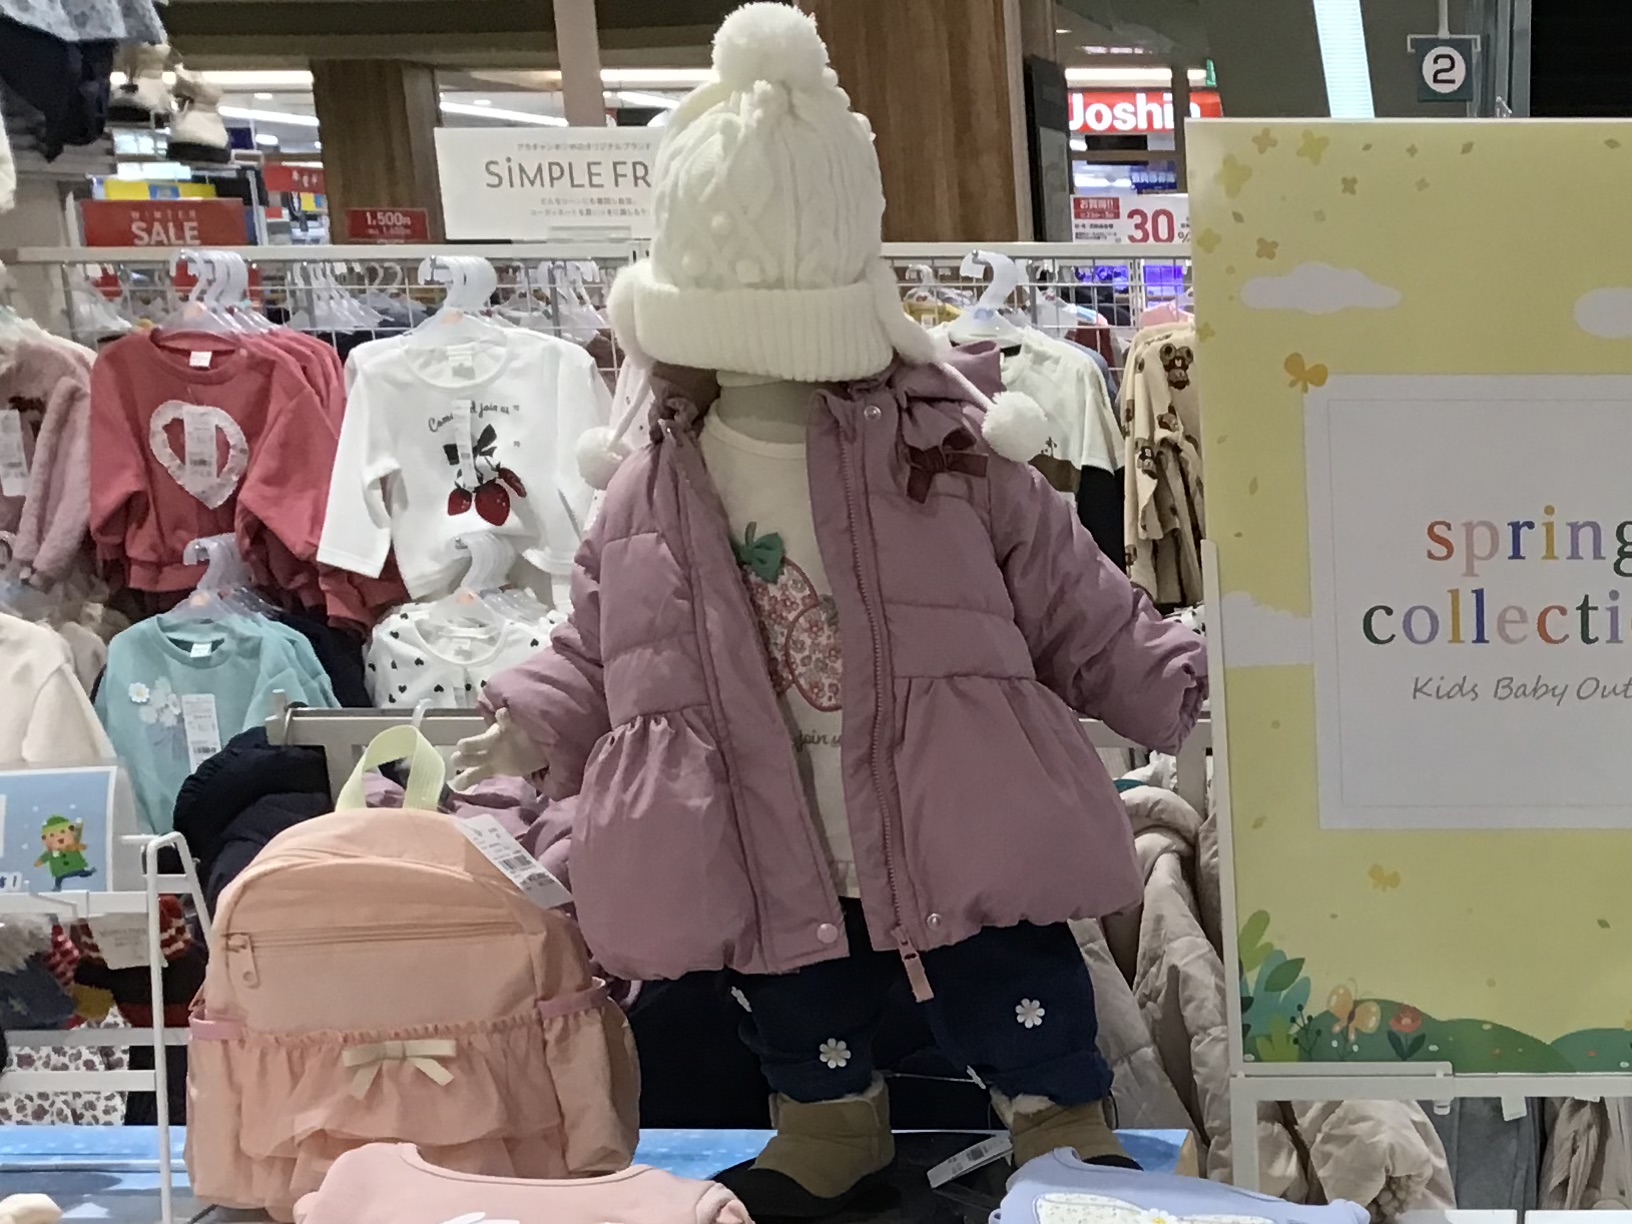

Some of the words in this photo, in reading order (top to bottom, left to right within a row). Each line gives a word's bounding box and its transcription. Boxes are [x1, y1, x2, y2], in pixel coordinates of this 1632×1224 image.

[1432, 54, 1456, 84] 2
[612, 161, 652, 188] FR
[131, 221, 201, 246] SALE
[1127, 208, 1175, 243] 30
[1411, 675, 1479, 702] Kids
[1493, 675, 1567, 707] Baby
